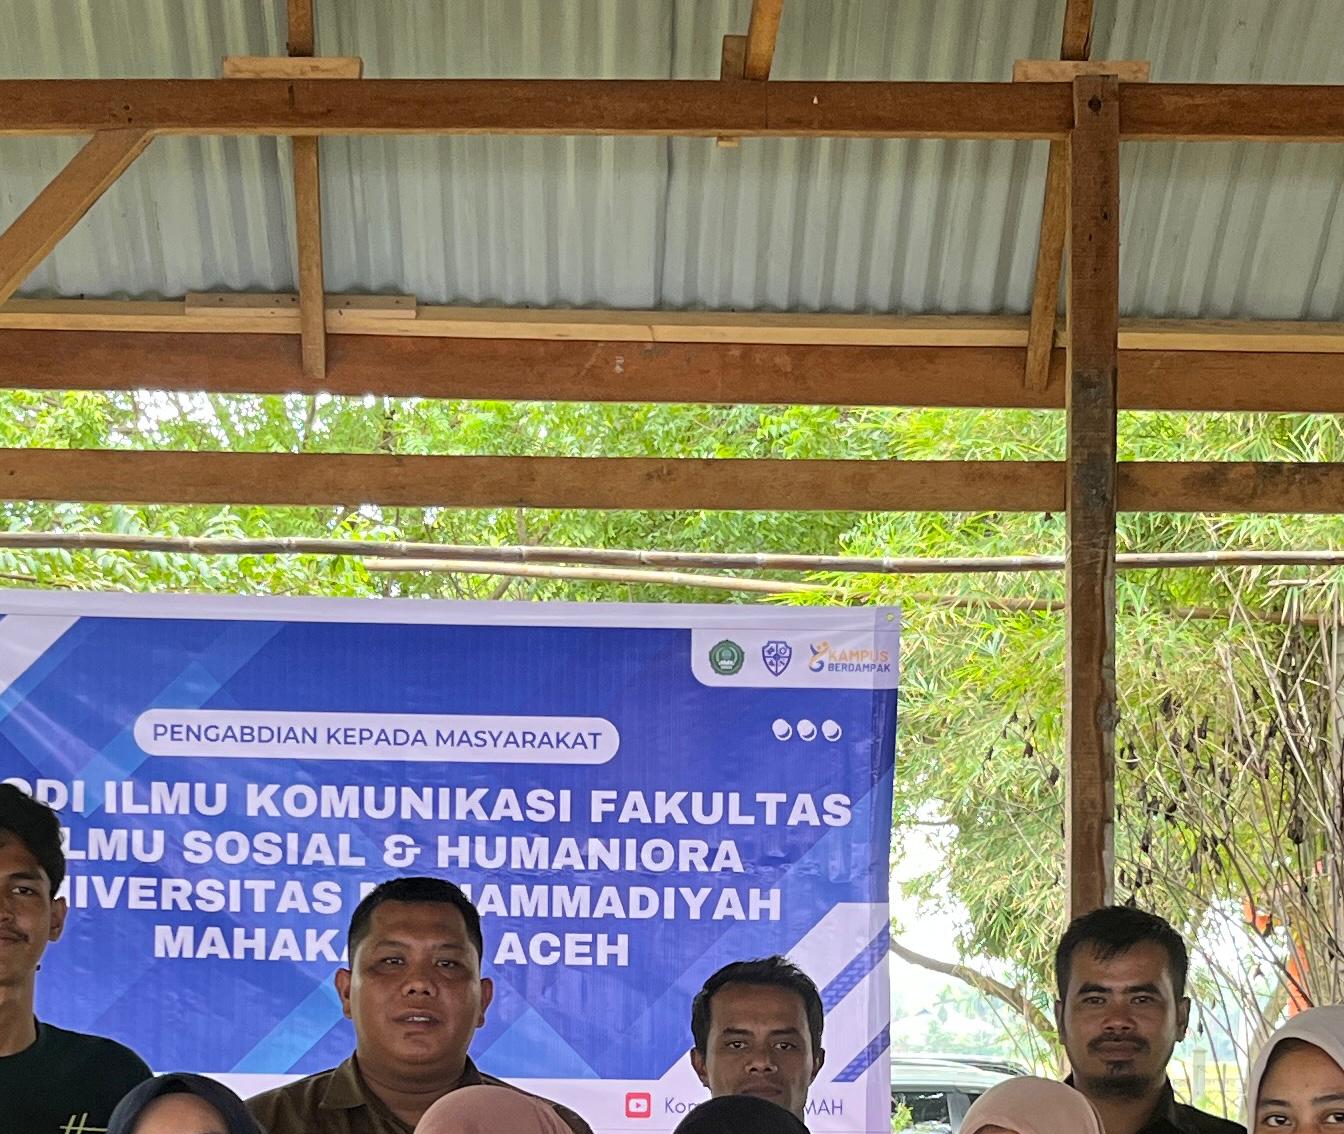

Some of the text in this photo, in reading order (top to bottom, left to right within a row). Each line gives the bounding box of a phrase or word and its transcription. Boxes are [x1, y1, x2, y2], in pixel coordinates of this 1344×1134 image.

[828, 663, 891, 673] BERDAMPAK
[829, 651, 888, 662] KAMPUS
[153, 723, 602, 751] PENGABDIAN KEPADA MASYARAKAT
[104, 780, 227, 816] ILMU
[246, 783, 571, 823] KOMUNIKASI
[590, 789, 852, 827] FAKULTAS
[60, 827, 745, 873] LMU SOSIAL & HUMANIORA
[56, 874, 781, 921] IVERSITAS AMMADIYAH
[154, 924, 629, 967] MAHAK ACEH
